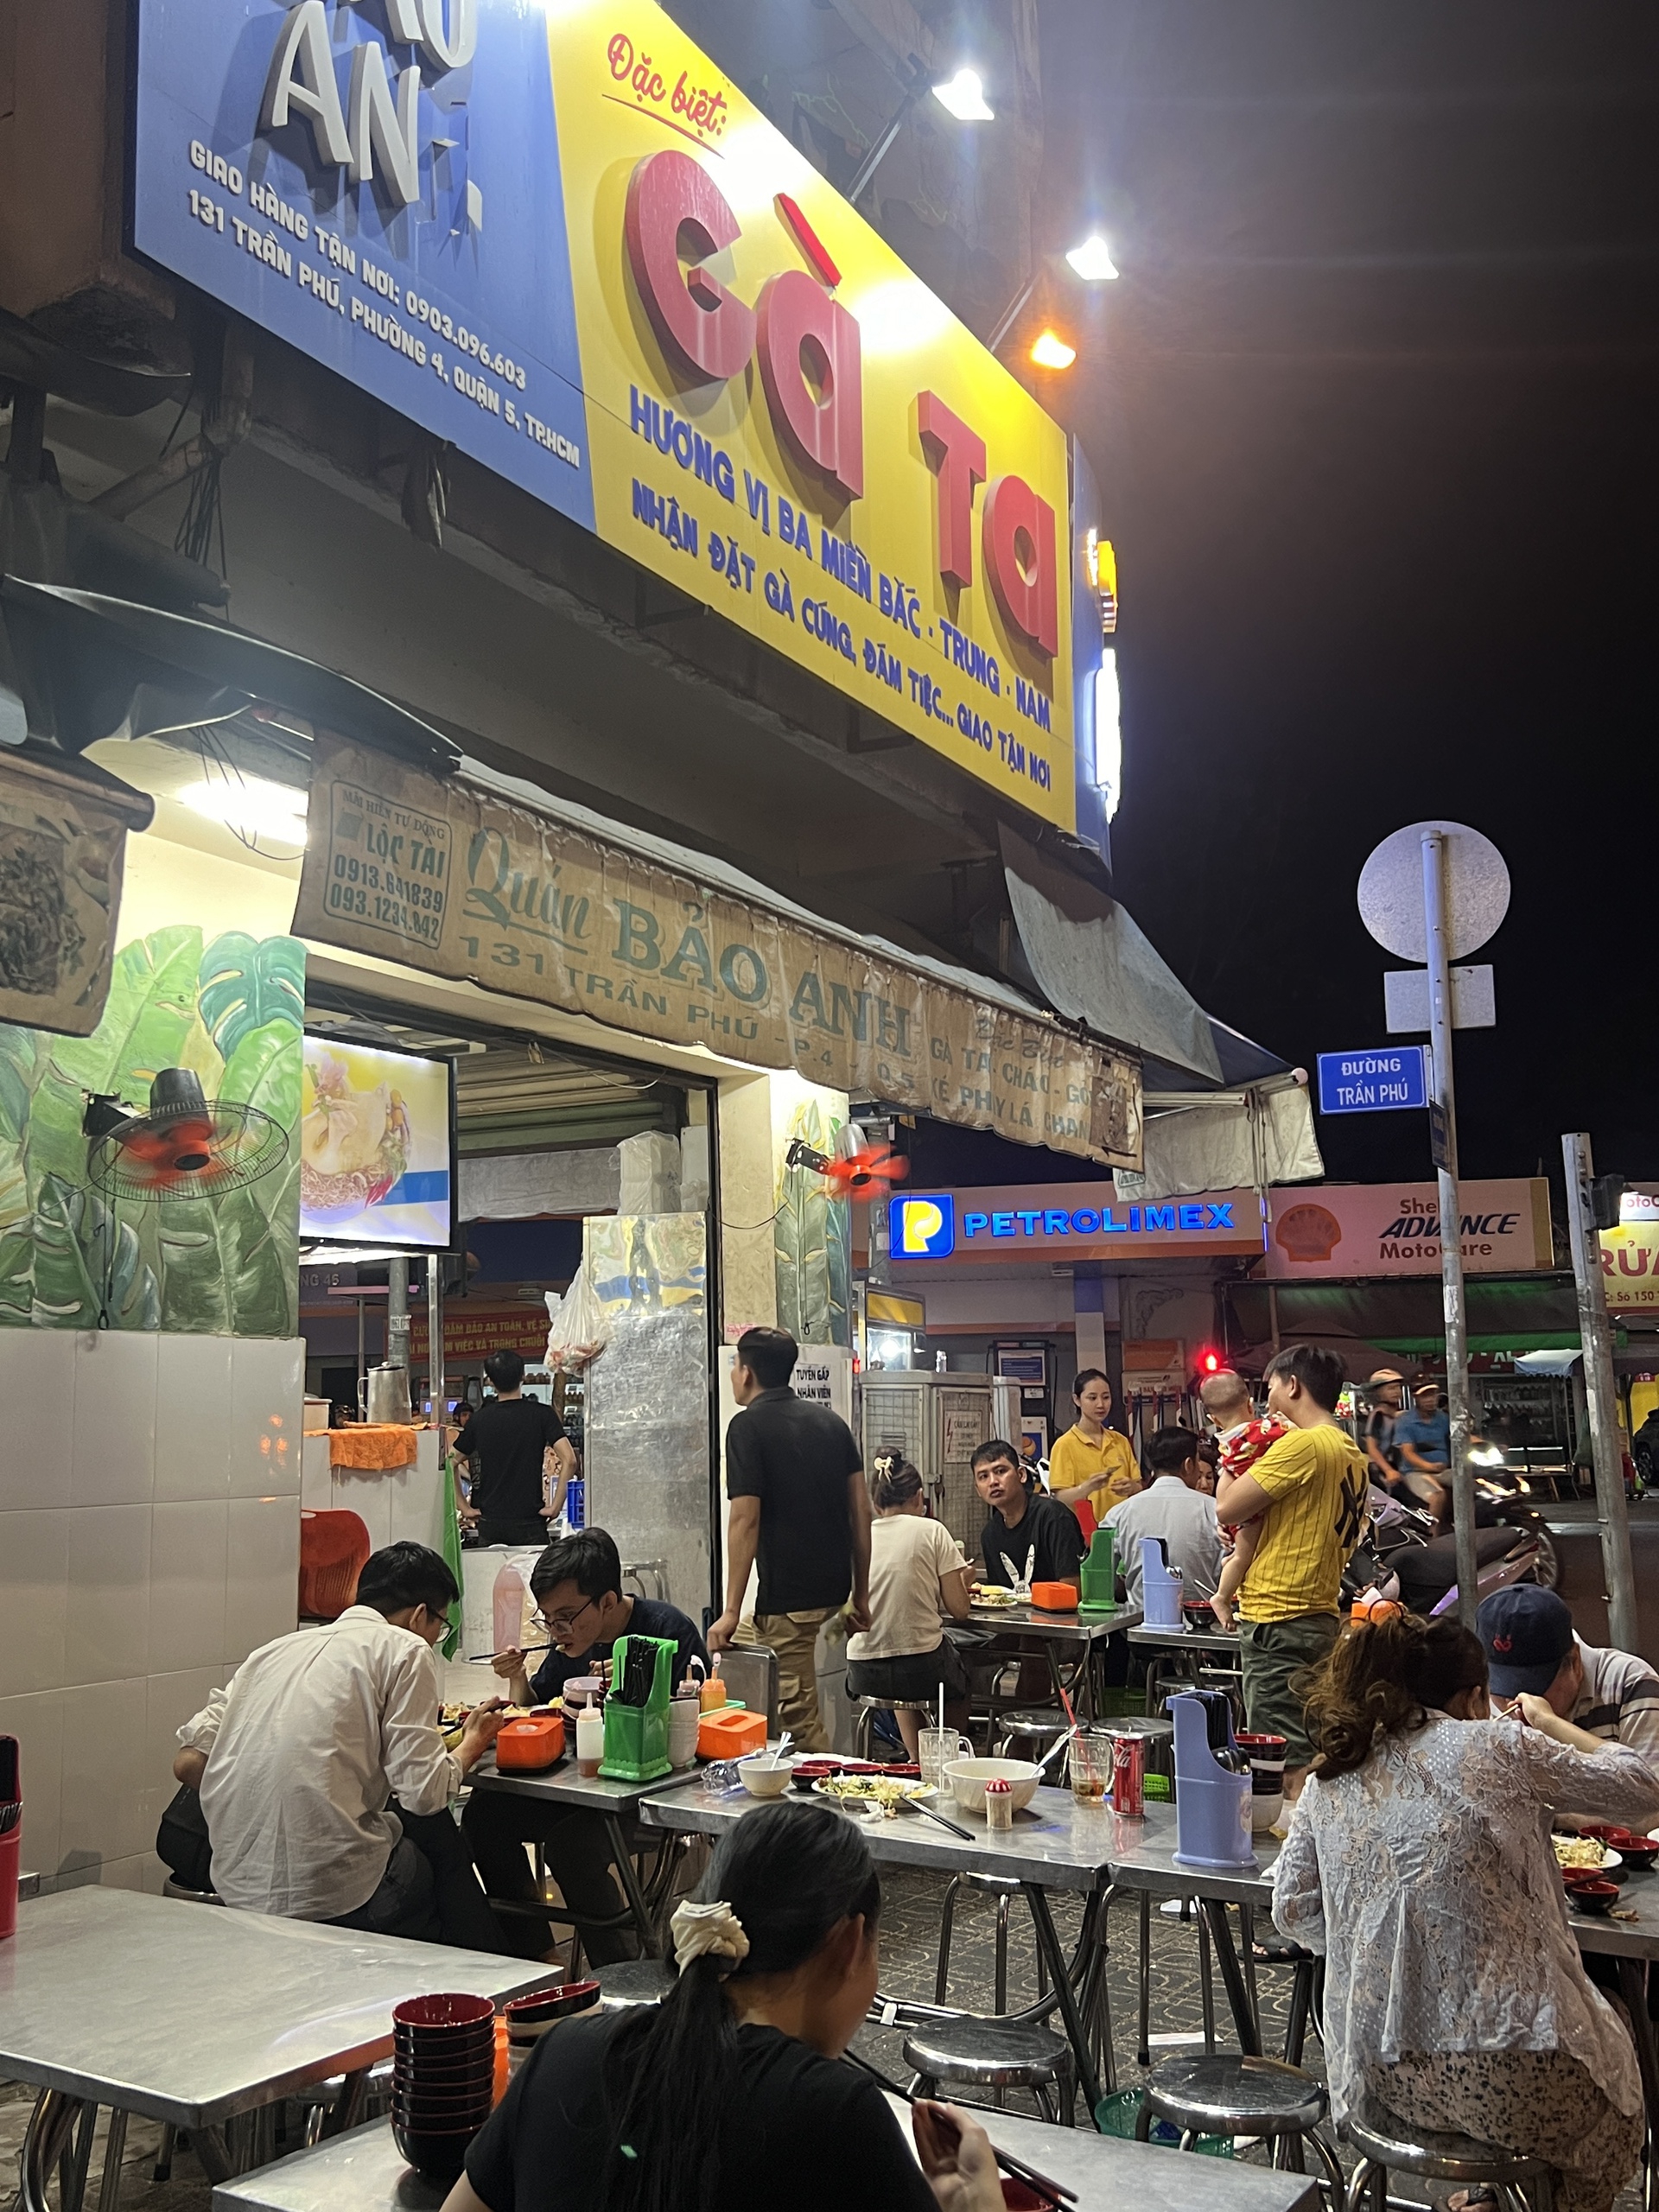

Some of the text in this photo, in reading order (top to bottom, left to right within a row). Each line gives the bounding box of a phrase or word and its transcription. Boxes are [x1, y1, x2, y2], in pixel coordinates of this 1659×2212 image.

[607, 33, 728, 137] Đặc biệt:
[190, 139, 526, 390] GIAO HÀNG TẬN NƠI: 0903.096.603
[189, 189, 581, 468] 131 TRẦN PHÚ, PHƯỜNG 4, QUẬN 5, TP.HCM
[918, 390, 1058, 658] Ta
[630, 384, 734, 504] HƯƠNG
[743, 468, 771, 536] VỊ
[779, 495, 812, 561] BA
[879, 572, 921, 639] BẮC
[939, 617, 1000, 697] TRUNG
[1015, 676, 1051, 734] NAM
[632, 477, 698, 558] NHẬN
[708, 531, 755, 593] ĐẶT
[764, 568, 795, 623] GÀ
[802, 597, 857, 666] CÚNG,
[862, 638, 903, 695] ĐÁM
[957, 702, 993, 752] GIAO
[998, 729, 1025, 775] TẬN
[367, 822, 446, 879] LỘC TÀI
[334, 854, 444, 914] 0913.641839
[465, 826, 912, 1058] Quán BẢO ANH
[459, 936, 544, 976] 131
[563, 963, 668, 1016] TRẦN
[687, 1003, 759, 1040] PHÚ
[931, 1035, 953, 1065] GÀ
[961, 1047, 992, 1074] TA
[1001, 1062, 1051, 1094] CHÁO
[1337, 1077, 1408, 1106] TRẦN PHÚ
[1341, 1057, 1402, 1076] ĐƯỜNG
[1044, 1110, 1090, 1141] CHAN
[963, 1203, 1236, 1237] PETROLIMEX
[1378, 1213, 1521, 1239] ADVNCE
[1400, 1197, 1440, 1215] She
[1380, 1243, 1492, 1259] Motoare
[1634, 1290, 1655, 1301] 150
